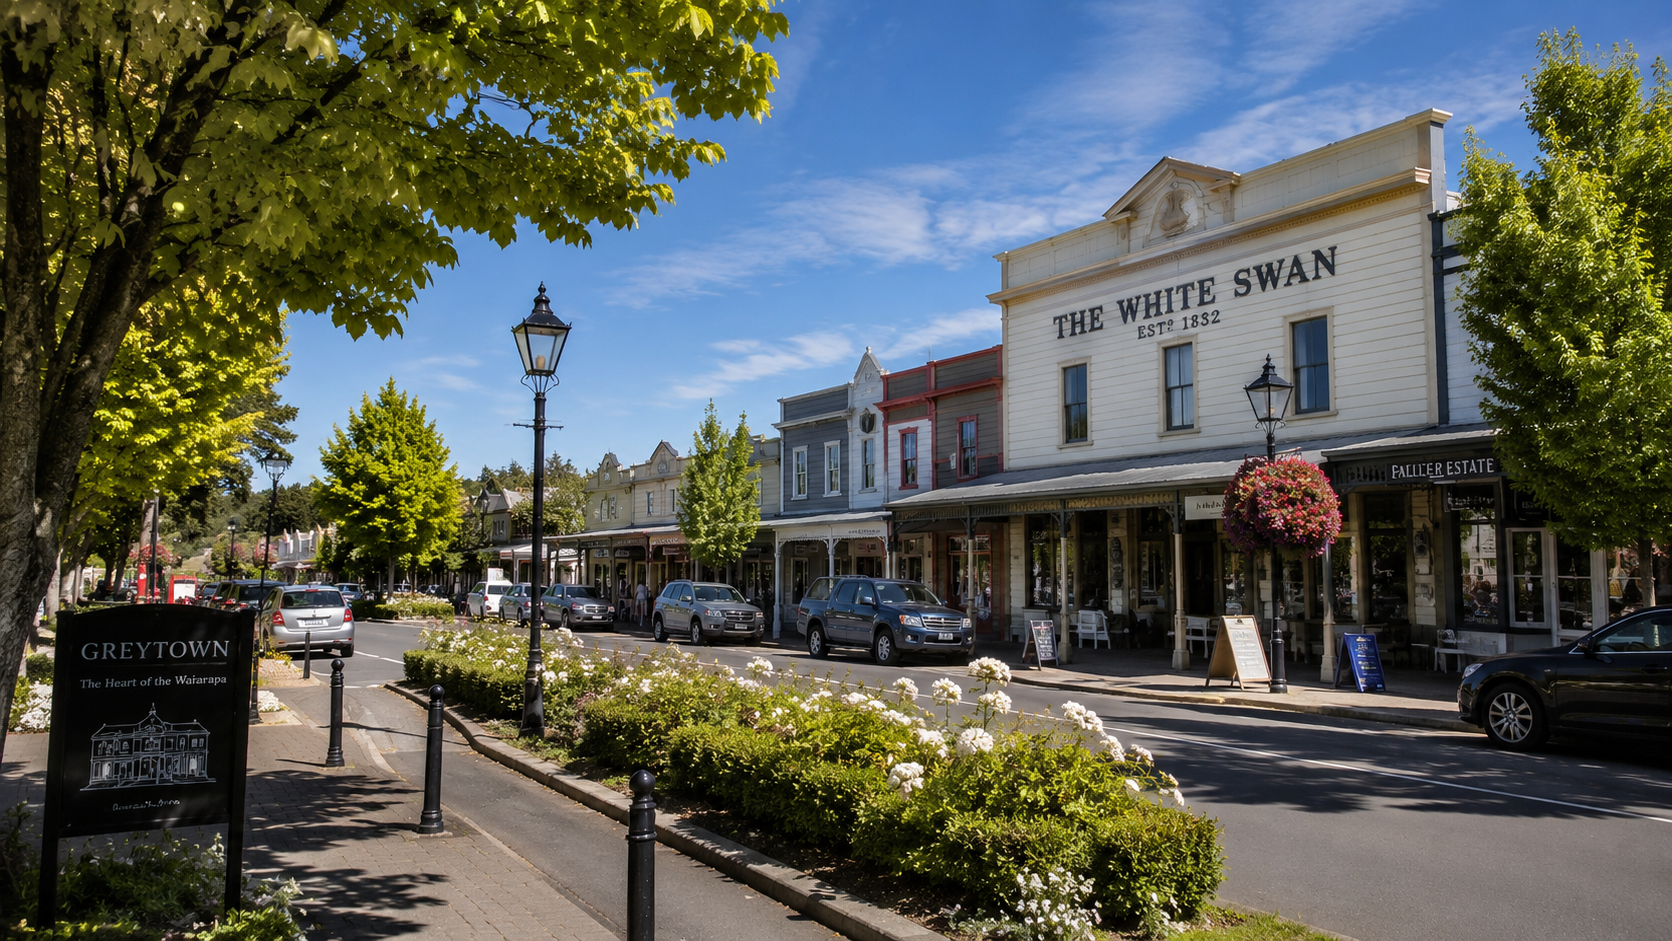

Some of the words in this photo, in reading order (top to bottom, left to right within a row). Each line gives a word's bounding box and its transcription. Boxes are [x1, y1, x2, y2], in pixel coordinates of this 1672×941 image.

[1053, 304, 1104, 339] THE
[1116, 276, 1216, 324] WHITE
[1234, 246, 1338, 298] SWAN
[1446, 457, 1495, 476] ESTATE
[81, 640, 230, 661] GREYTOWN
[79, 678, 102, 689] The
[105, 677, 137, 688] Heart
[139, 676, 153, 687] of
[154, 676, 172, 686] the
